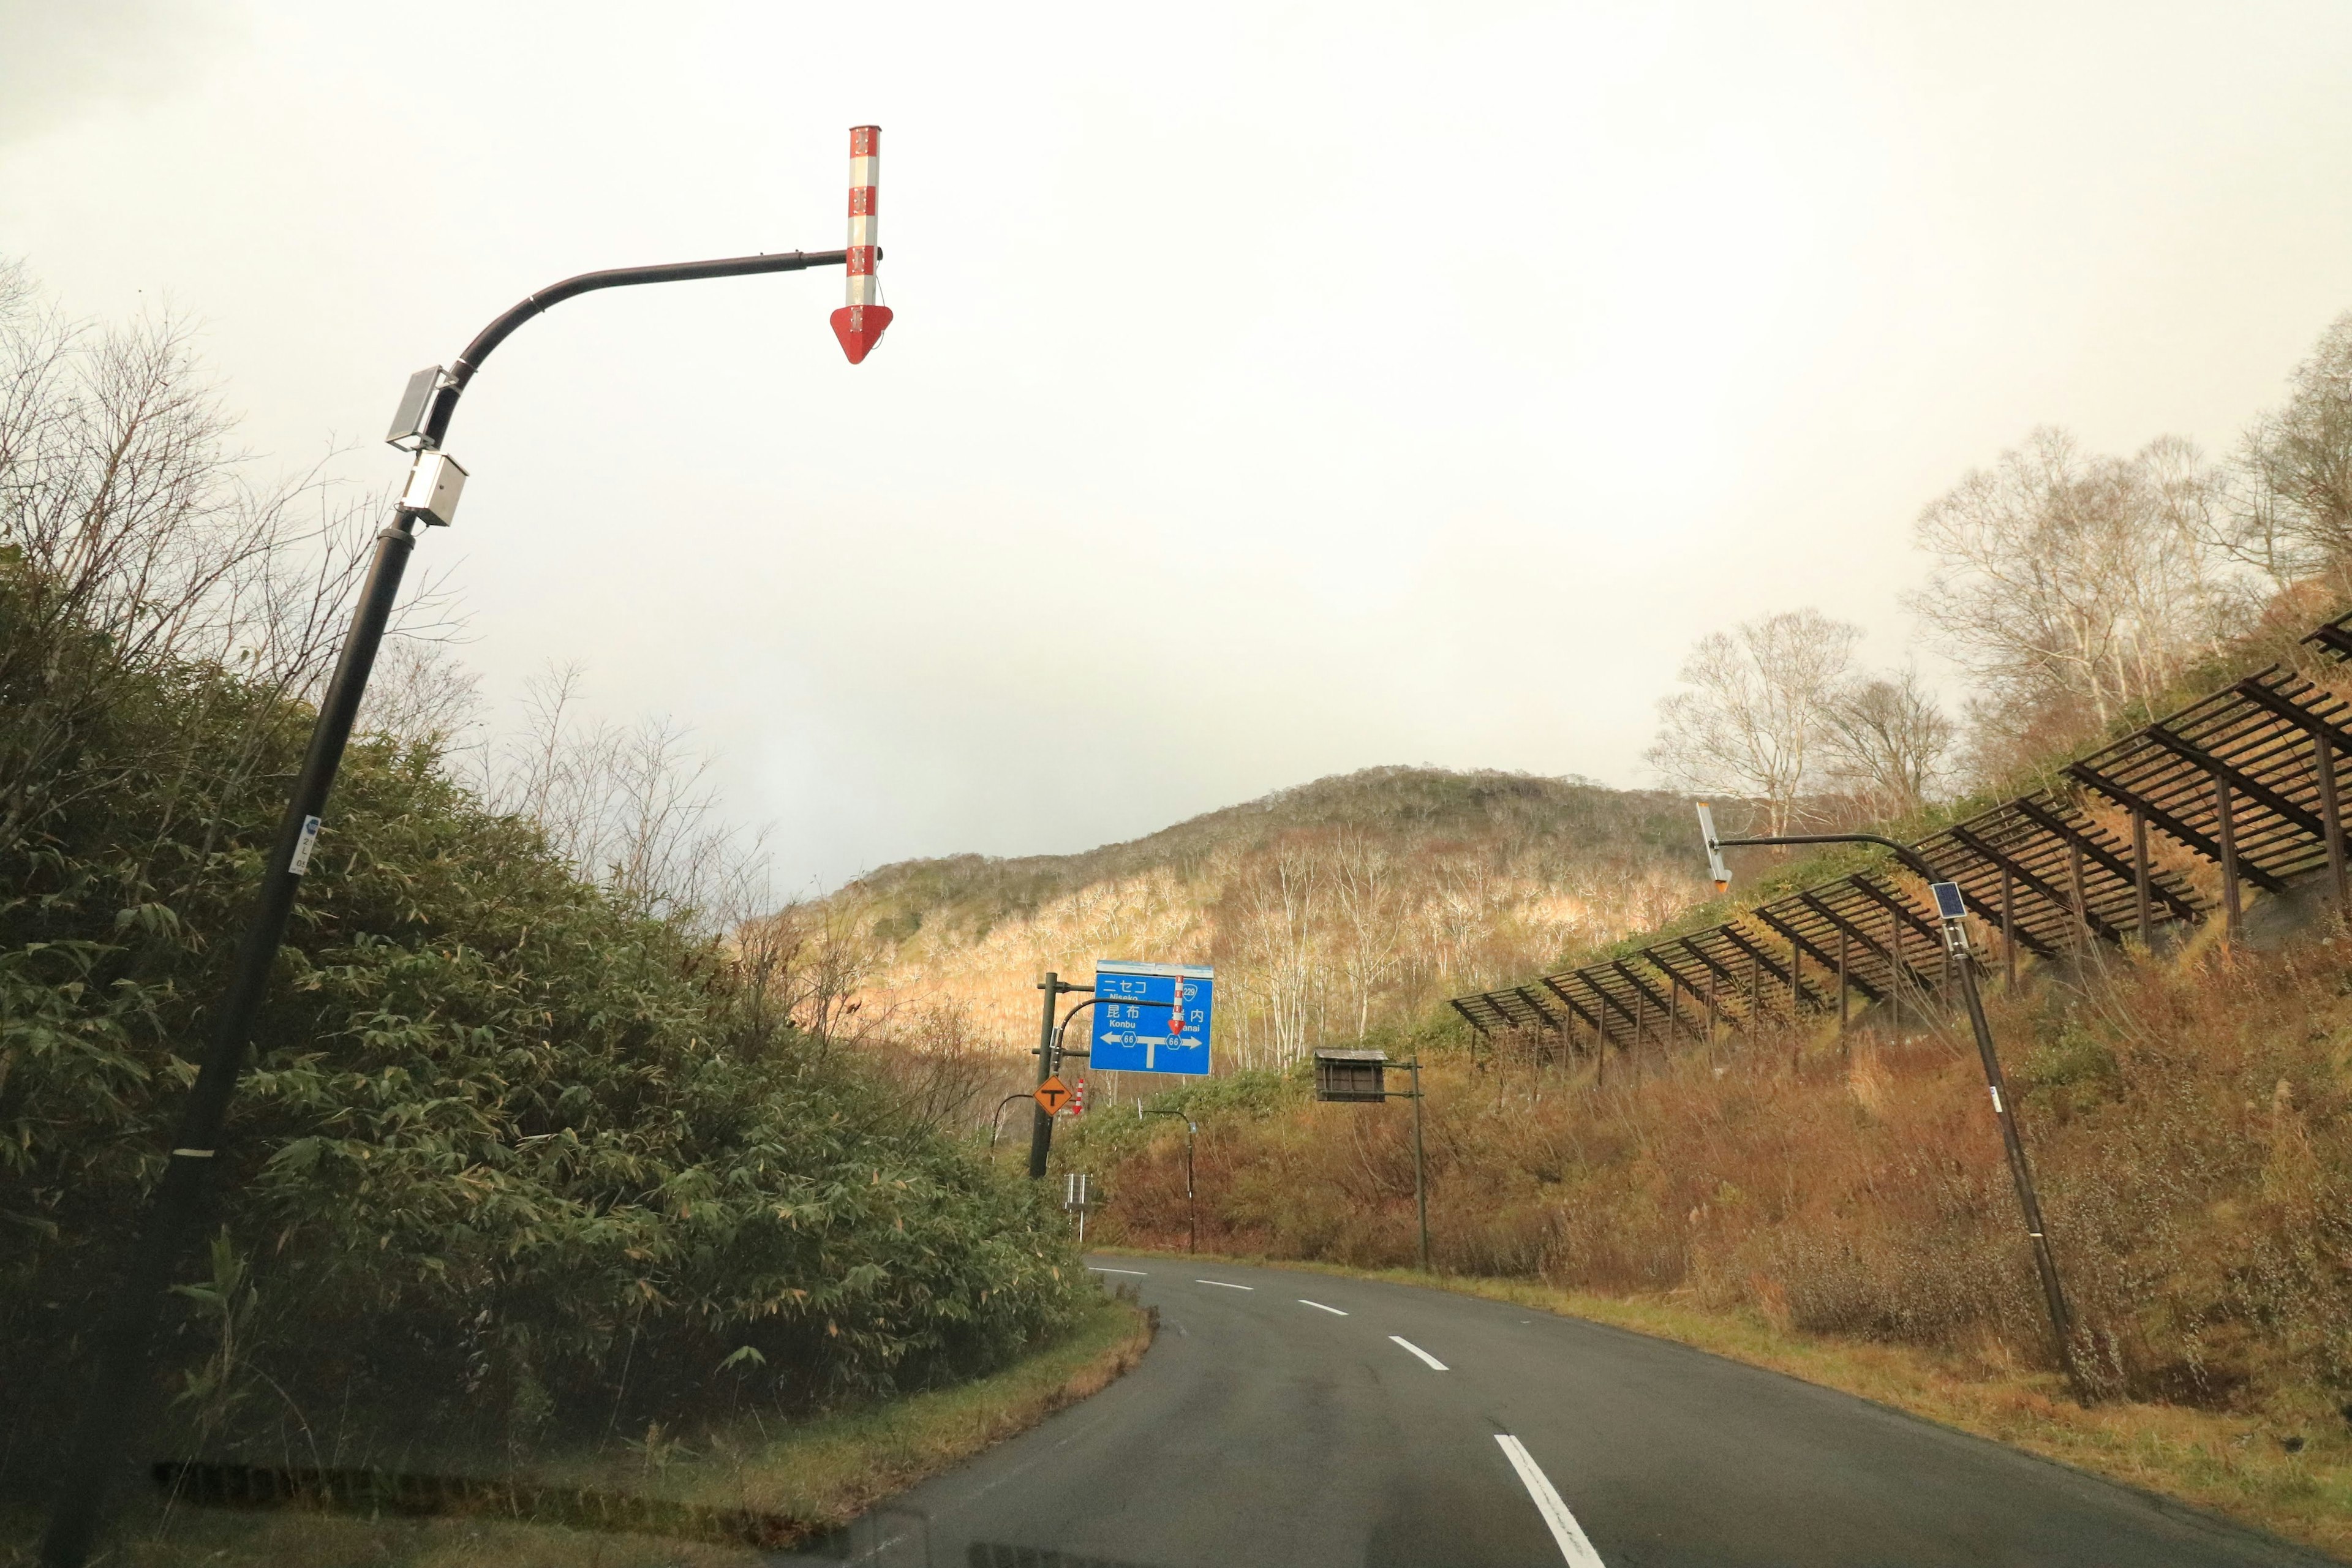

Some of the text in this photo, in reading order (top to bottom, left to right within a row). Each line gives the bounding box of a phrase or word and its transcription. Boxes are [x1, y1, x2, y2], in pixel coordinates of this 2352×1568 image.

[1103, 980, 1146, 993] ニセコ
[1106, 1005, 1140, 1019] 昆布
[1109, 1019, 1136, 1028] Konbu
